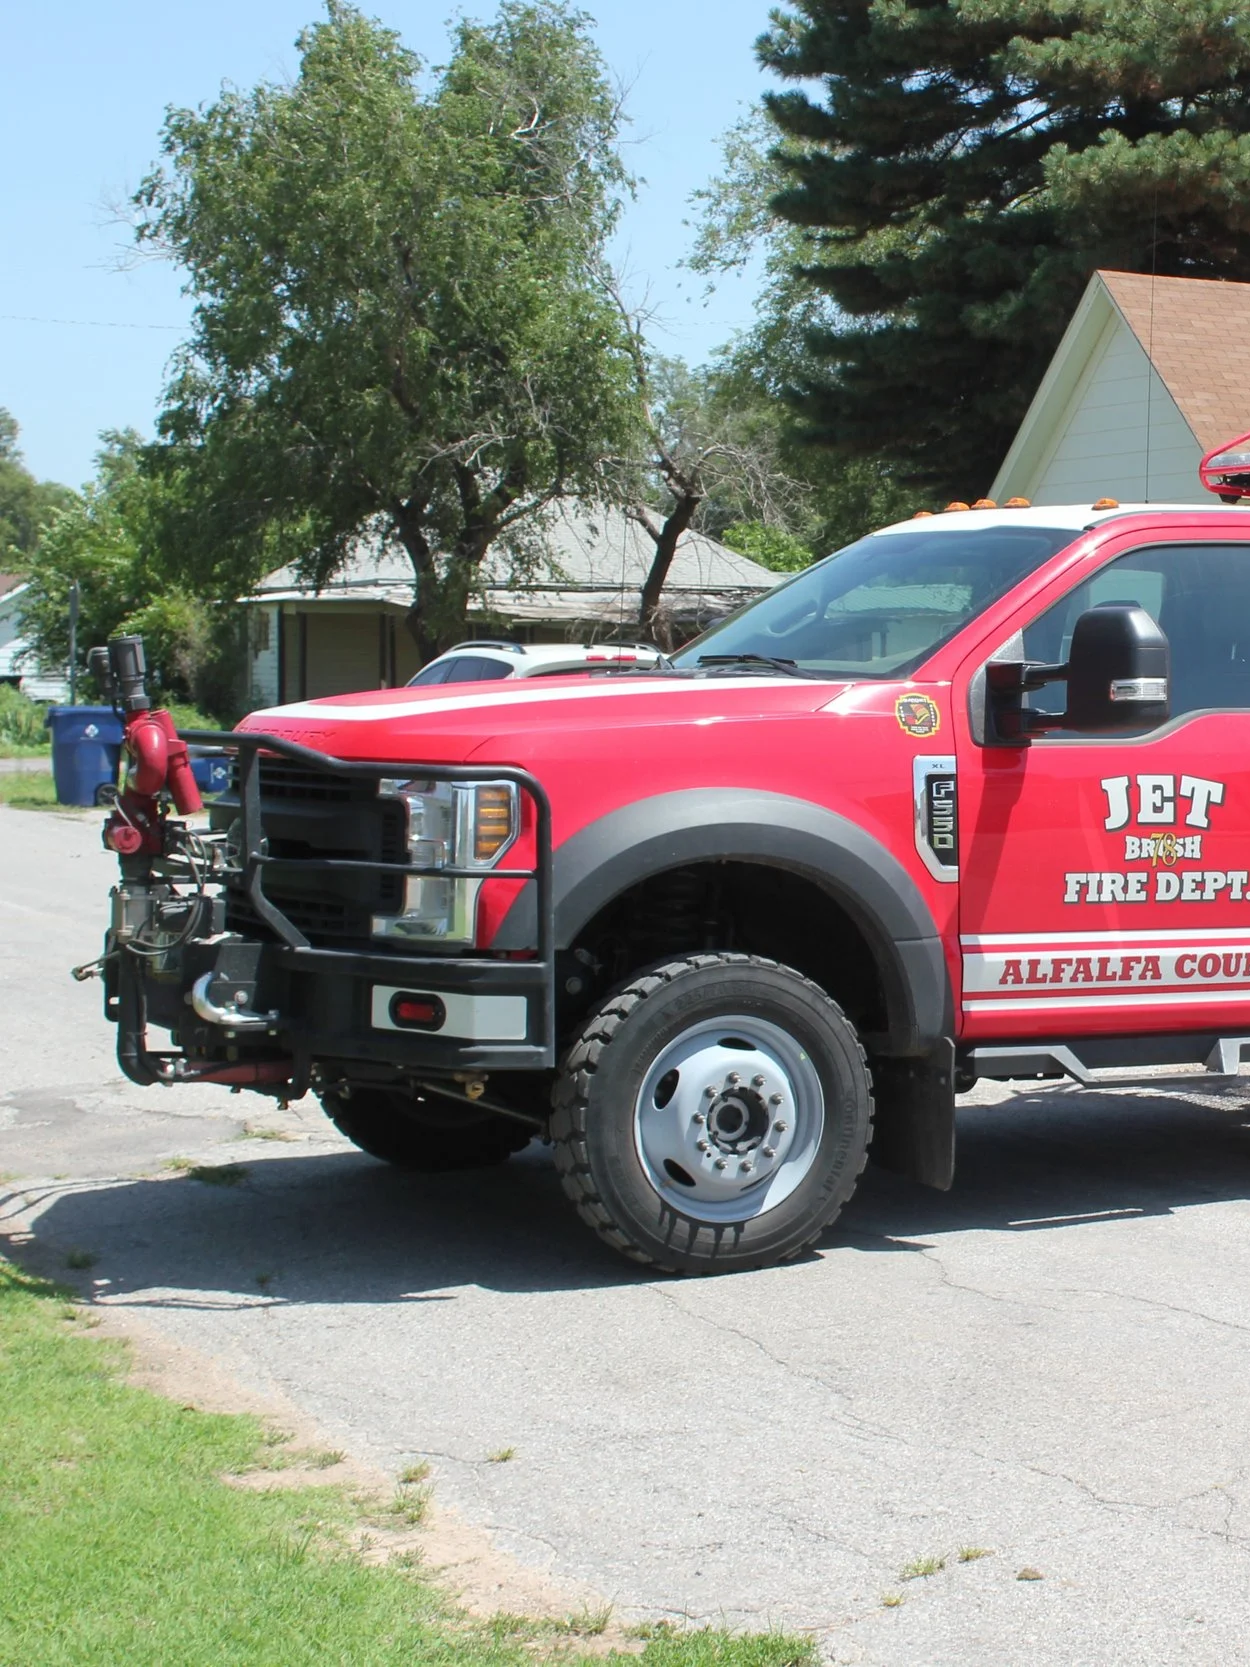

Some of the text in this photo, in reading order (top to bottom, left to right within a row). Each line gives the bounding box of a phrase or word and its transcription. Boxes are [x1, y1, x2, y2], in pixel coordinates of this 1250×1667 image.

[1101, 774, 1224, 831] JET
[1150, 832, 1177, 867] 78
[1063, 872, 1148, 903] FIRE
[999, 955, 1162, 985] ALFALFA
